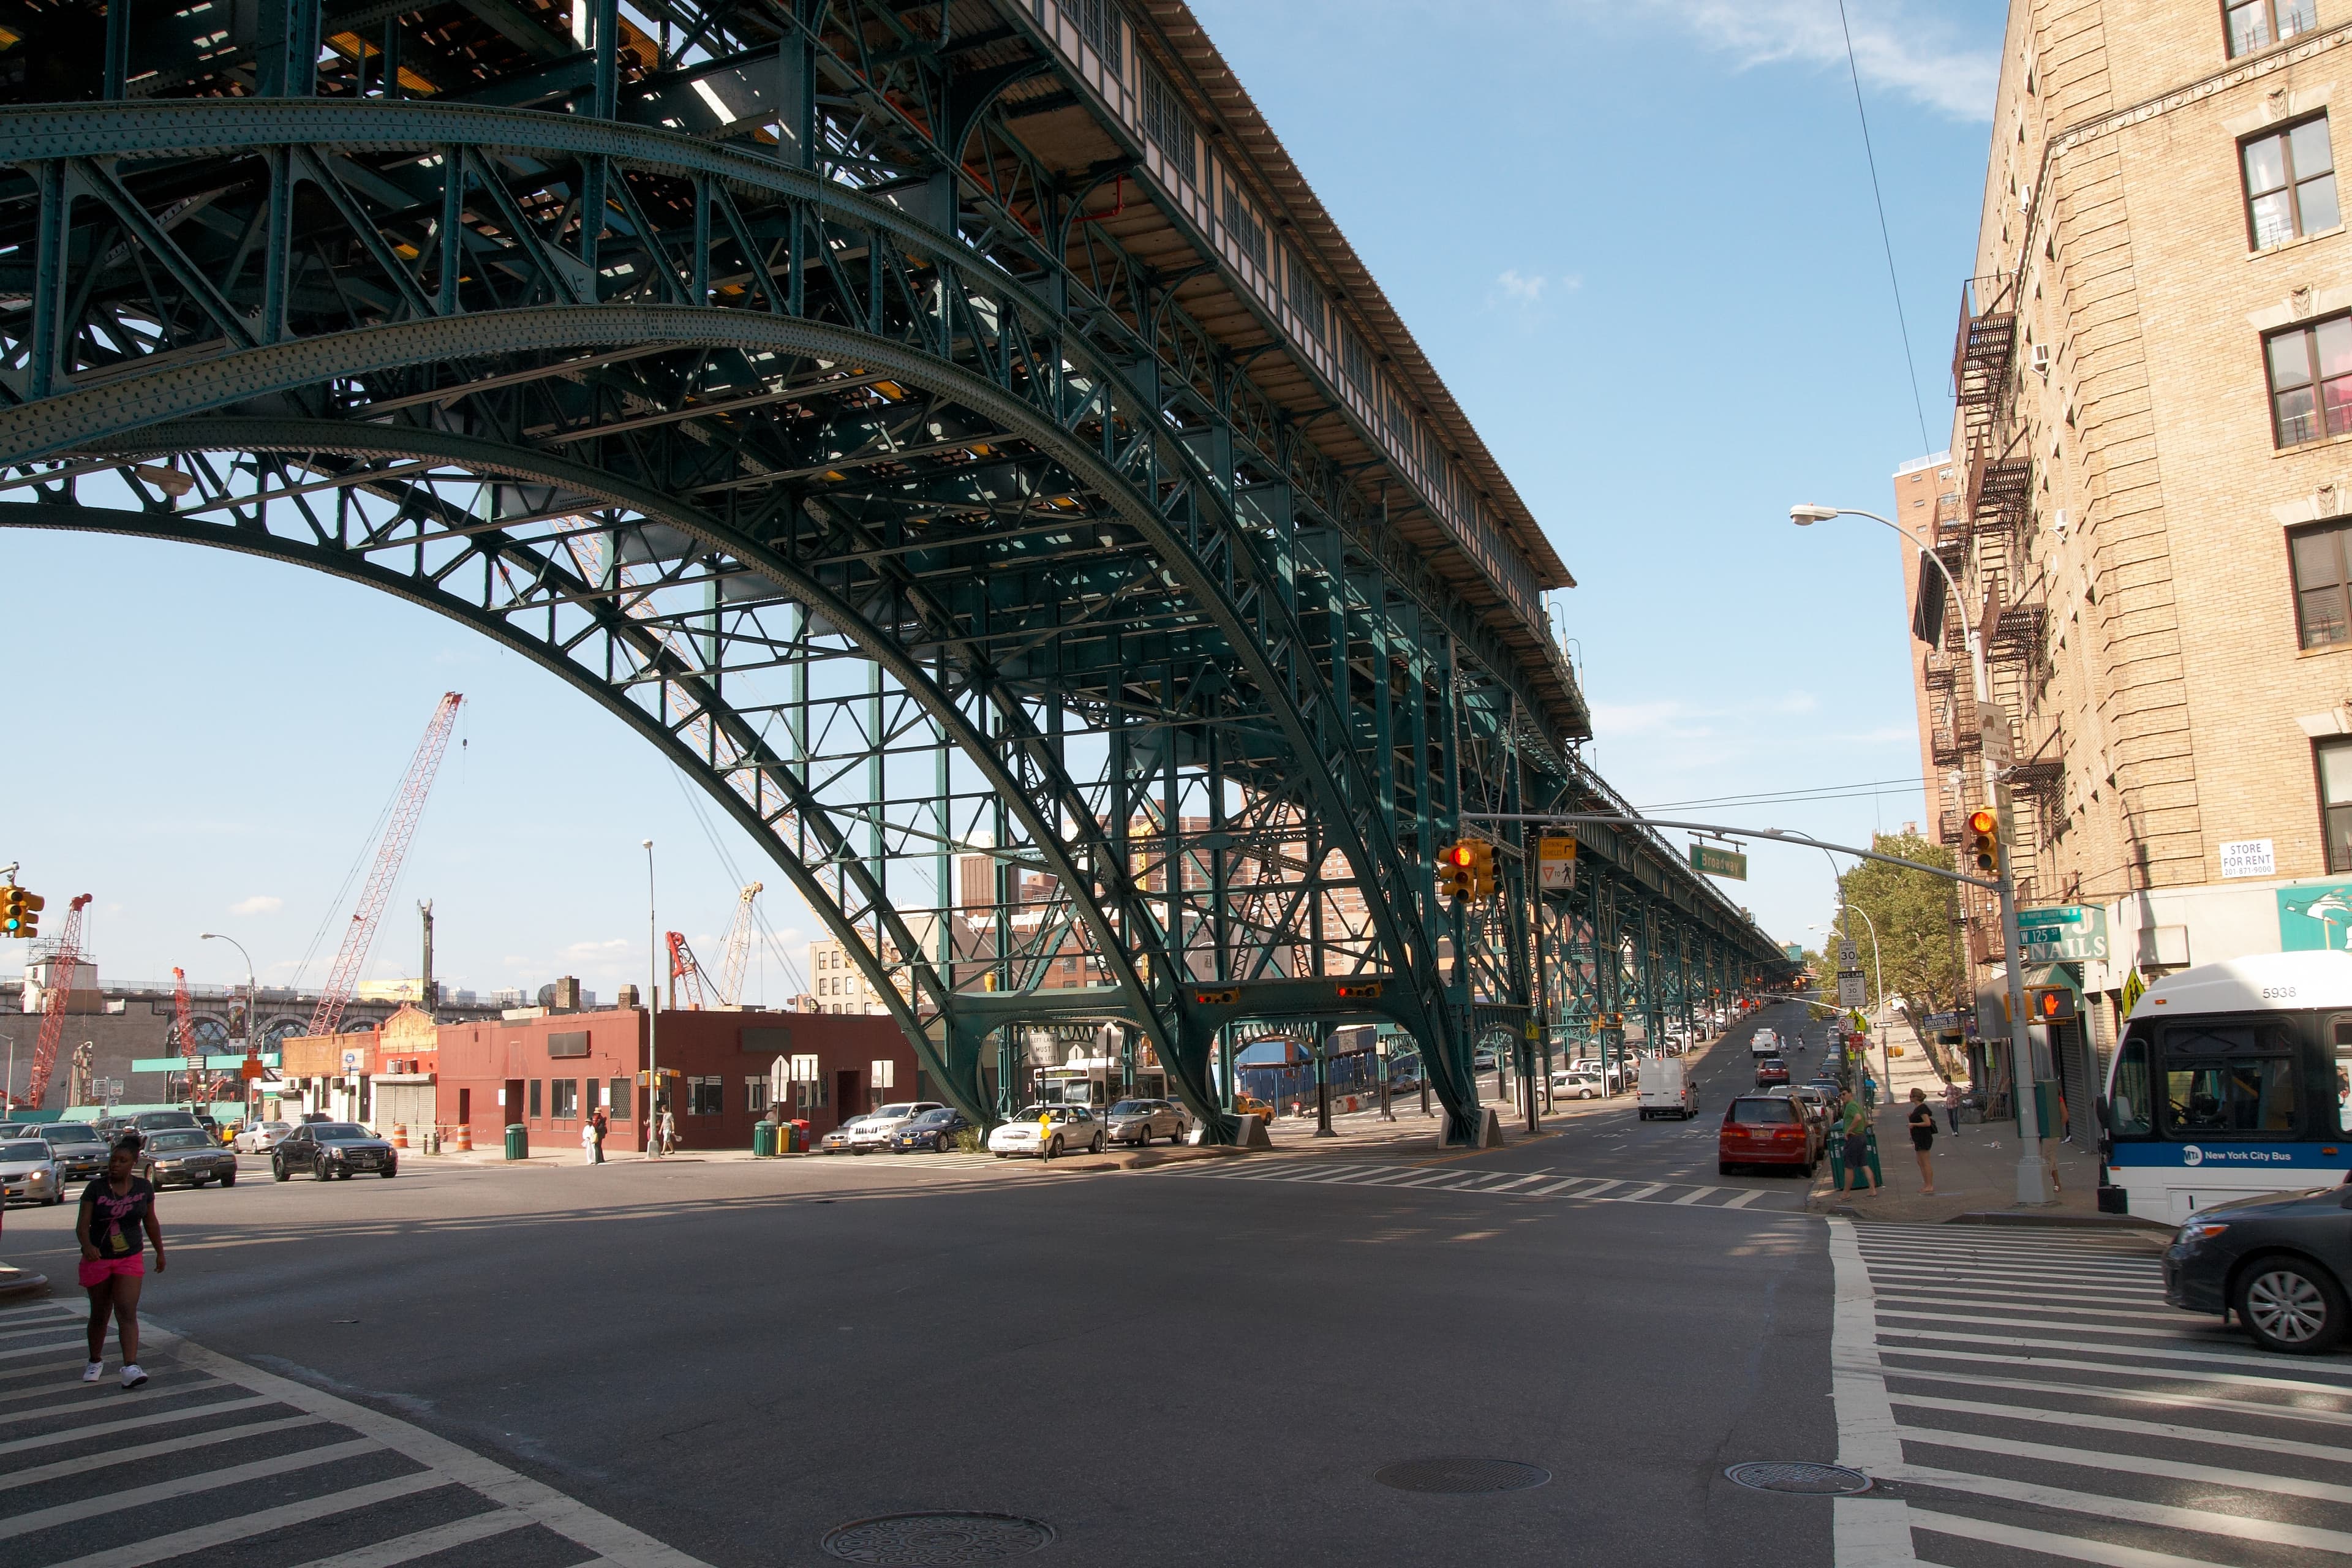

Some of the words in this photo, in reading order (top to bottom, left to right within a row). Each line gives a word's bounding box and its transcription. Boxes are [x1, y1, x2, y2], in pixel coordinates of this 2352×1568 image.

[2230, 843, 2261, 854] STORE
[1702, 853, 1739, 875] Broadway
[2223, 857, 2243, 867] FOR
[2245, 854, 2271, 865] RENT
[2225, 865, 2271, 875] 201-871-9000
[2021, 931, 2028, 943] W
[2032, 930, 2048, 942] 125
[2030, 937, 2106, 960] NAILS
[1841, 951, 1855, 960] 30
[2263, 987, 2296, 998] 5938
[1925, 1018, 1947, 1027] DRIVING
[2250, 1152, 2270, 1161] City
[97, 1192, 145, 1206] Pucker
